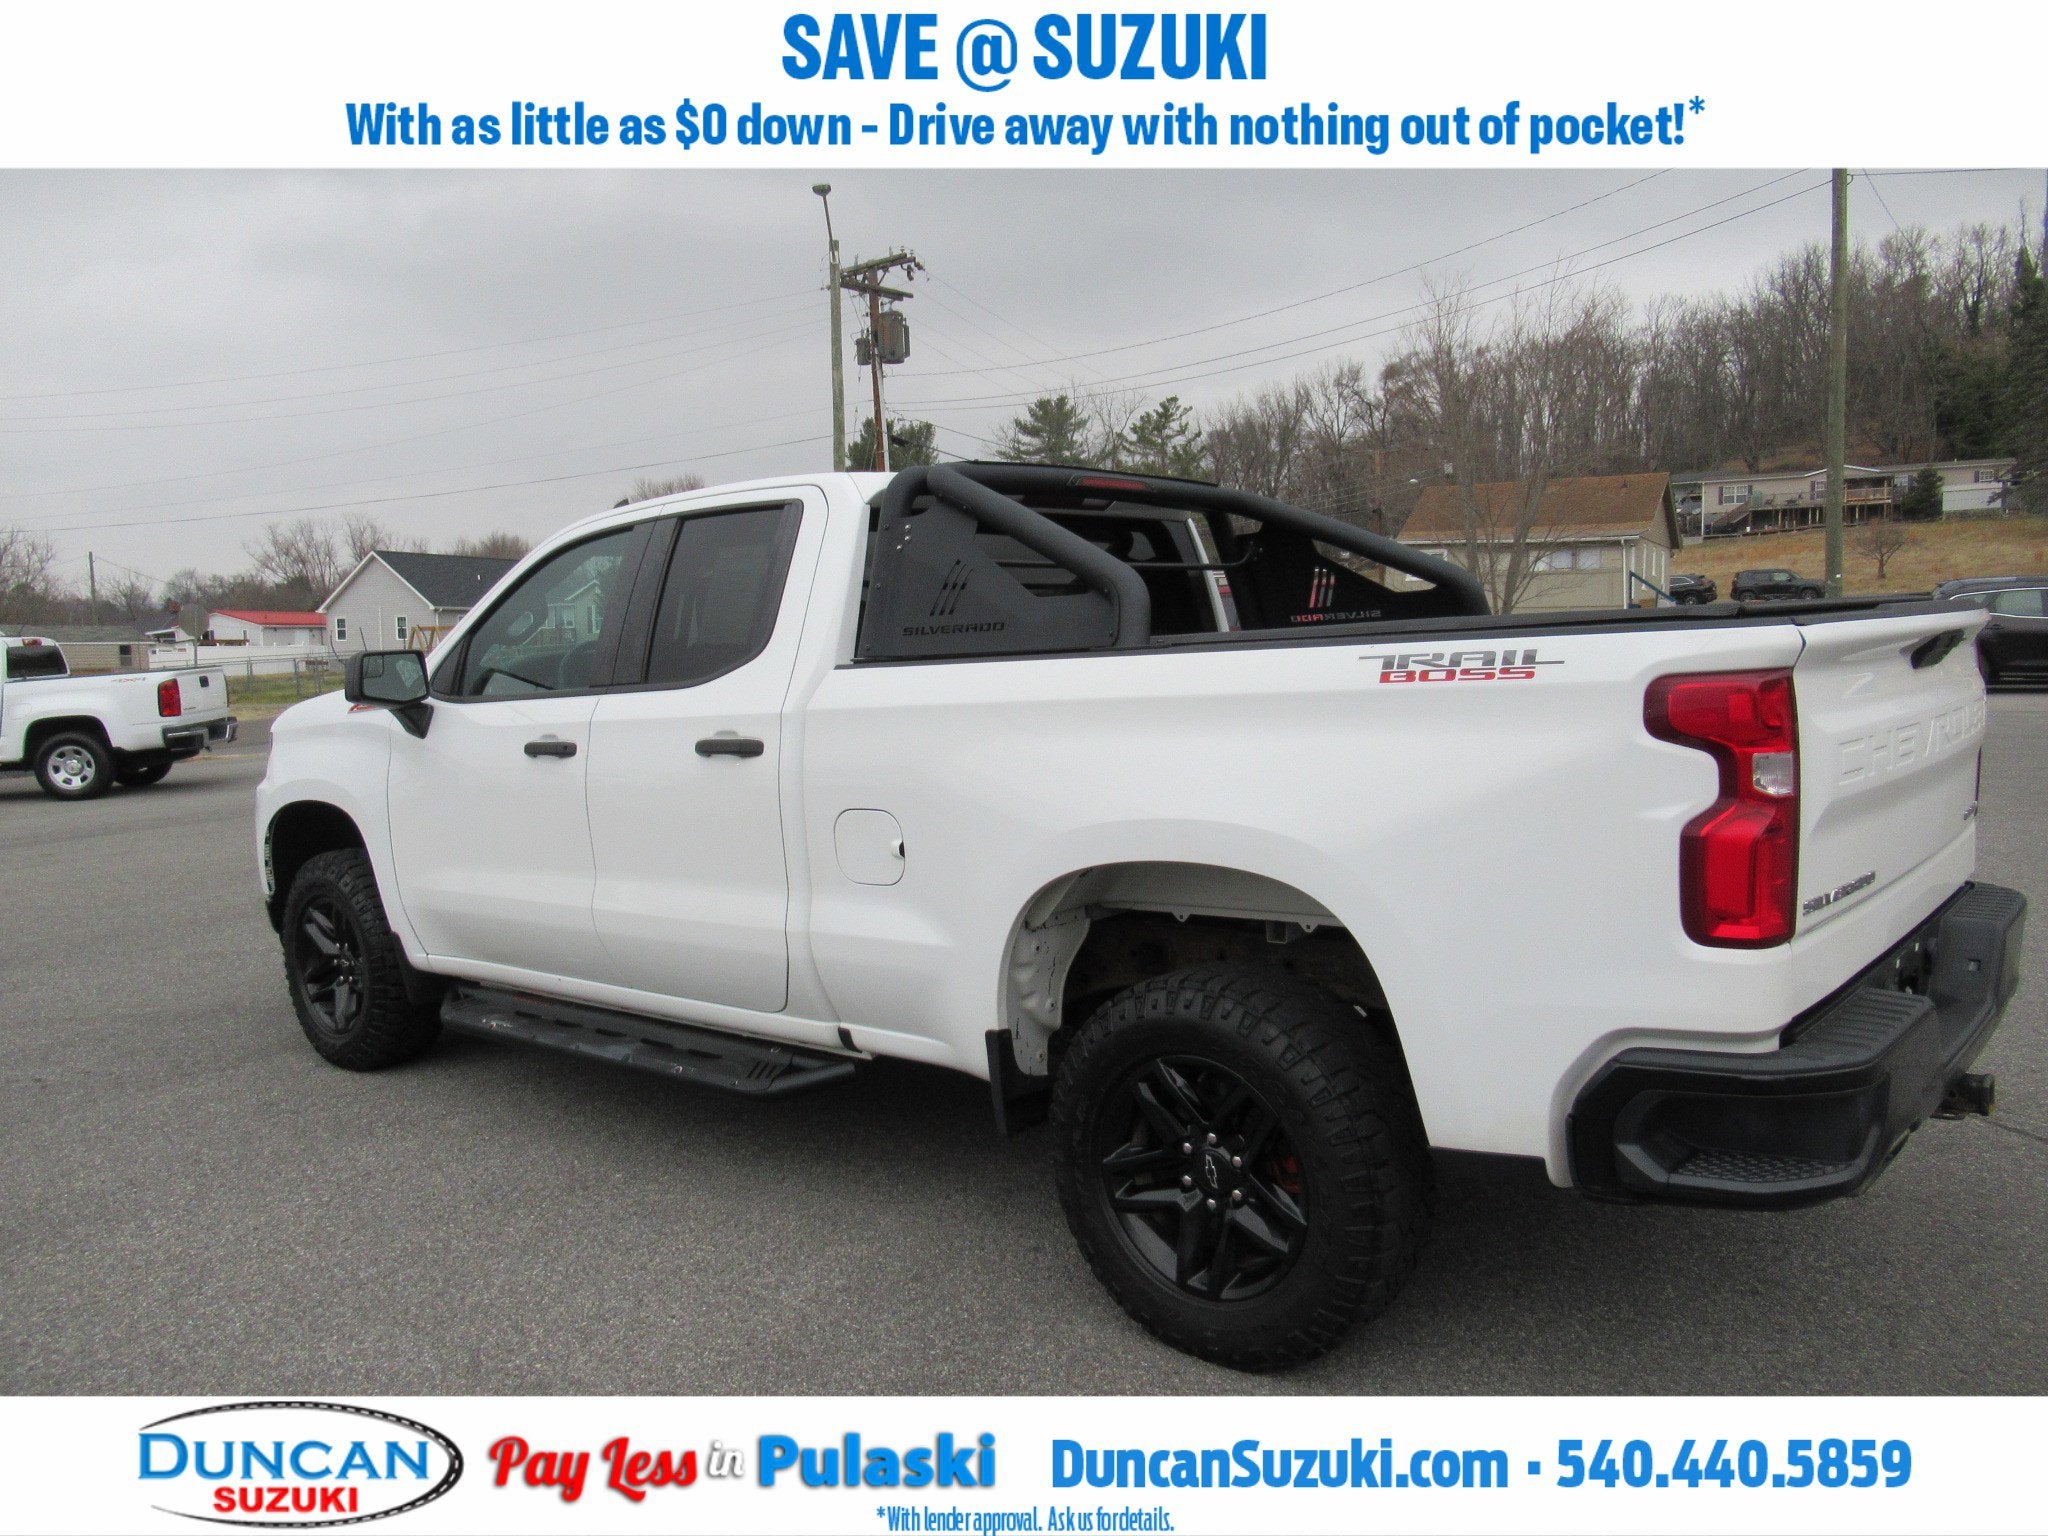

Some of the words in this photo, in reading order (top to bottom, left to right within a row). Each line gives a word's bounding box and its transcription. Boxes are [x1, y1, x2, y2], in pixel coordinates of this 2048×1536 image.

[901, 622, 1005, 636] SILVERADO
[1358, 648, 1565, 670] TRAIL
[1379, 666, 1536, 684] BOSS
